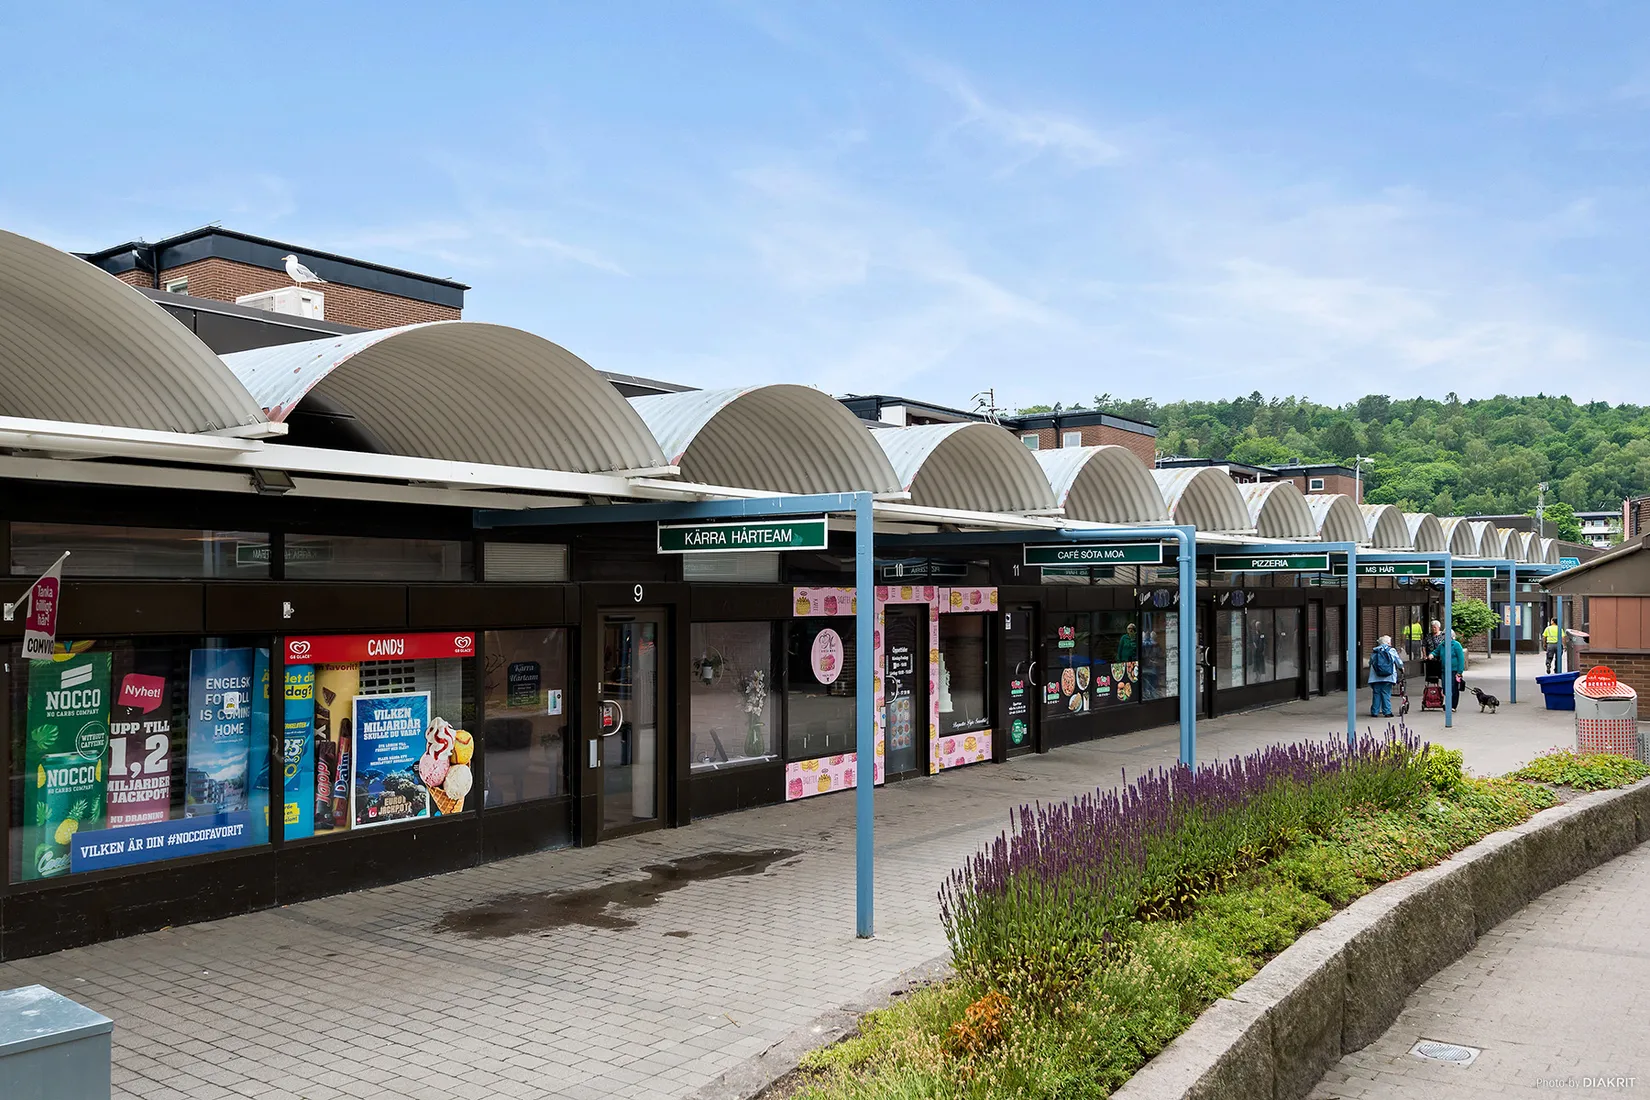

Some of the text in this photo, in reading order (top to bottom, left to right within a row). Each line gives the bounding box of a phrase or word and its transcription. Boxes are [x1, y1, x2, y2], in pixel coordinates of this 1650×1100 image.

[684, 526, 793, 545] KÄRRA HÅRTEAM
[1057, 548, 1126, 560] CAFÉ SÖTA MOA
[895, 563, 904, 577] 10
[1012, 564, 1020, 577] 11
[1251, 558, 1289, 569] PIZZERIA
[1379, 565, 1395, 573] HÅR
[37, 585, 53, 598] Tanka
[633, 584, 643, 602] 9
[36, 599, 53, 614] billigt
[37, 613, 50, 626] här!
[367, 638, 404, 656] CANDY
[325, 663, 358, 671] favorit?
[205, 676, 251, 690] ENGELSK
[124, 684, 161, 698] Nyhet!
[285, 685, 313, 699] dag?
[45, 688, 101, 711] NOCCO
[56, 709, 75, 717] CARBS
[76, 708, 99, 716] COMPANY
[199, 709, 213, 721] IS
[373, 707, 412, 721] VILKEN
[110, 720, 170, 735] UPP TILL
[214, 723, 244, 737] HOME
[363, 729, 421, 740] SKULLE DU VARA?
[80, 739, 105, 749] CAFFEINE
[81, 732, 105, 742] WITHOUT
[109, 734, 169, 779] 1,2
[46, 765, 95, 788] NOCCO
[107, 775, 171, 792] MILJARDER
[333, 753, 350, 800] Daim
[55, 786, 73, 794] CARBS
[316, 761, 332, 807] Japp
[111, 787, 169, 804] JACKPOT!
[110, 811, 164, 824] NU DRAGNING
[80, 843, 125, 859] VILKEN
[127, 838, 144, 852] ÄR
[146, 835, 164, 849] DIN
[167, 824, 243, 847] #NOCCOFAVORIT
